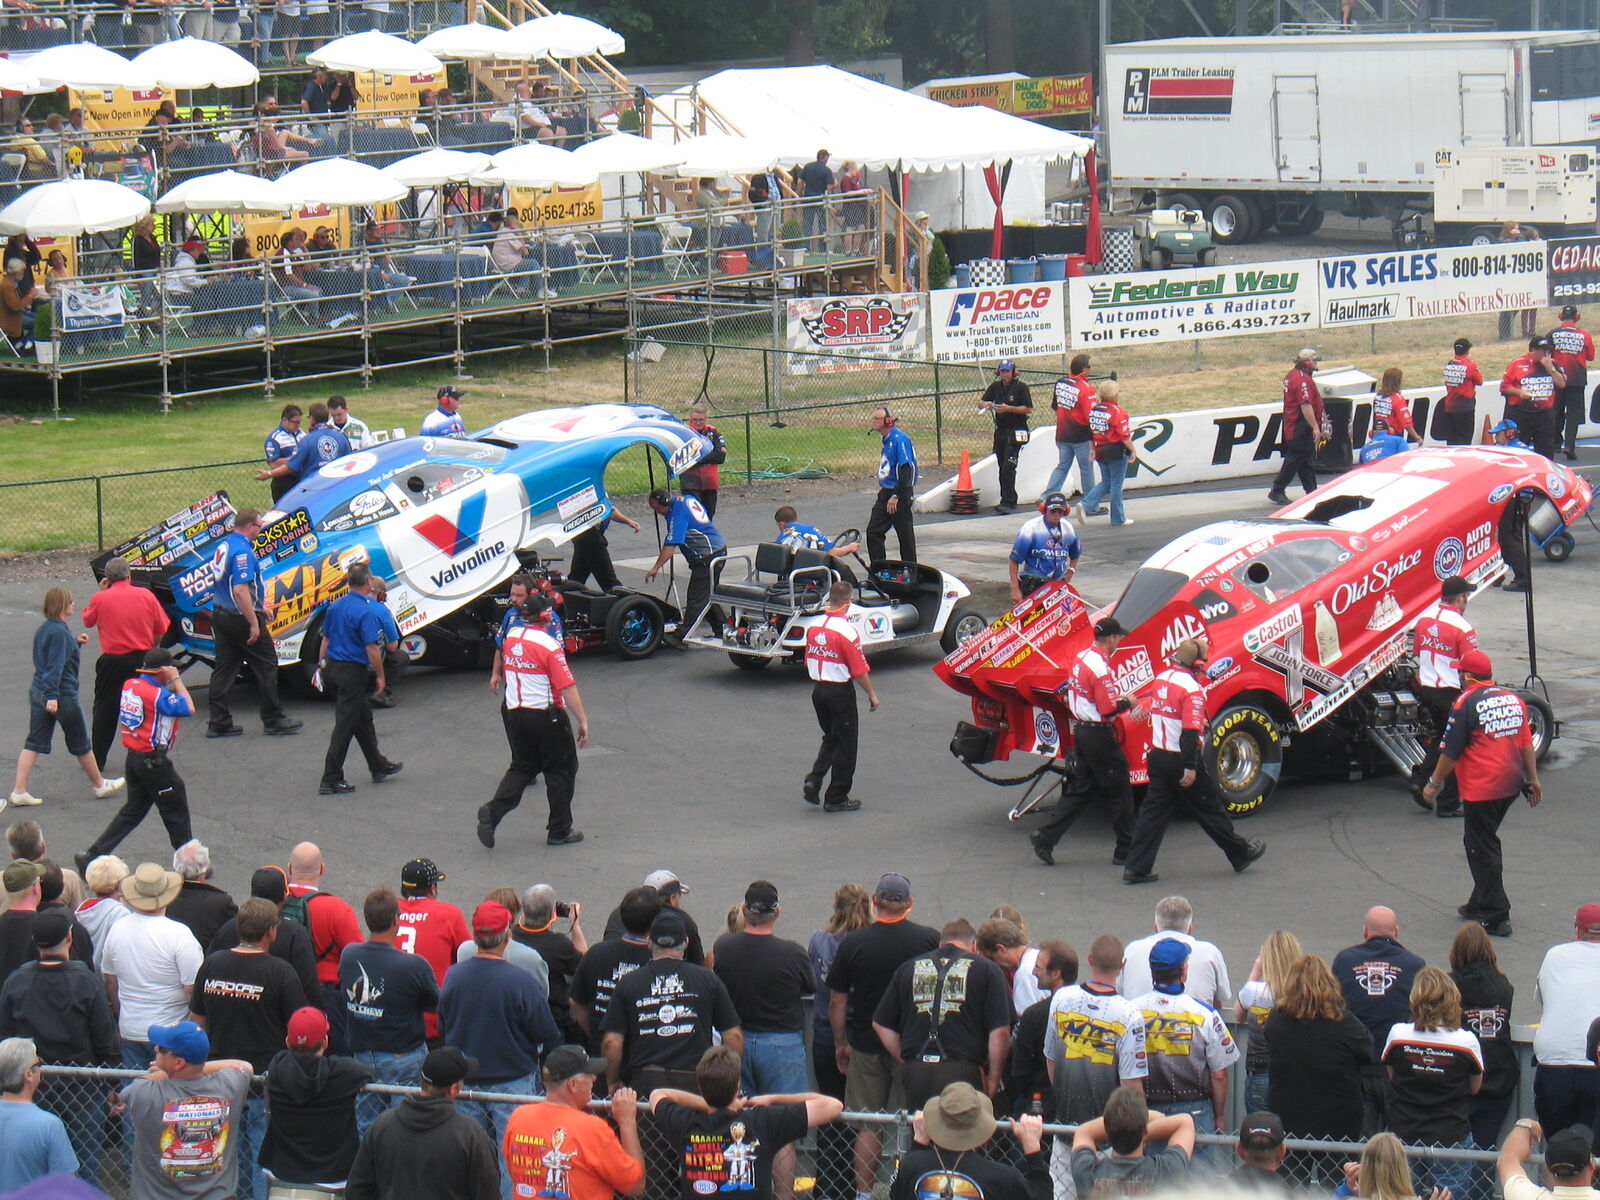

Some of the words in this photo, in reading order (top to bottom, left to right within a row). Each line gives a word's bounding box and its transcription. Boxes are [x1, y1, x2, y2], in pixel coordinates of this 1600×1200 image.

[1150, 68, 1169, 77] PLM
[1172, 68, 1200, 77] Trailer
[1202, 67, 1235, 79] Leasing
[391, 89, 410, 102] Open
[930, 89, 967, 101] CHICKEN
[970, 86, 999, 99] STRIPS
[1026, 100, 1047, 110] DOGS
[111, 109, 132, 121] Open
[1435, 151, 1452, 164] CAT
[1323, 261, 1358, 290] VR
[1366, 253, 1438, 287] SALES
[1452, 252, 1544, 278] 800-814-7996
[1111, 274, 1227, 303] Federal
[1235, 271, 1299, 293] Way
[970, 286, 1051, 325] pace
[1095, 305, 1195, 325] Automotive
[1205, 302, 1214, 315] &
[1224, 299, 1296, 314] Radiator
[1329, 301, 1391, 321] Haulmark
[823, 307, 892, 338] SRP
[981, 311, 1038, 323] AMERICAN
[946, 321, 1052, 339] www.TruckTownSales.com
[1081, 329, 1113, 342] Toll
[1120, 327, 1160, 339] Free
[1177, 312, 1312, 335] 1.866.439.7237
[966, 333, 1033, 348] 1-800-671-0026
[936, 352, 951, 362] BIG
[953, 347, 996, 360] Discounts!
[999, 346, 1020, 356] HUGE
[1022, 343, 1063, 356] Selection!
[206, 505, 233, 524] FRAM
[565, 508, 603, 531] FREIGHTLINER
[254, 540, 278, 558] ERGY
[281, 523, 312, 545] DRINK
[1466, 521, 1492, 542] AUTO
[1215, 550, 1249, 574] MIKE
[1246, 535, 1276, 556] NEFF
[1466, 536, 1491, 561] CLUB
[180, 560, 215, 588] MAT
[430, 540, 505, 589] Valvoline
[1331, 575, 1370, 615] Old
[1369, 549, 1423, 593] Spice
[271, 617, 289, 632] MAIL
[400, 611, 428, 633] FRAM
[1258, 611, 1300, 645] Castrol
[1161, 613, 1206, 659] MAC
[816, 646, 841, 659] Spice
[513, 656, 538, 670] Spice
[954, 651, 981, 674] FEATHERLITE
[1270, 649, 1300, 670] JOHN
[1300, 661, 1335, 688] FORCE
[1475, 694, 1520, 713] CHECKER
[1212, 709, 1279, 747] GOODYEAR
[1484, 716, 1523, 735] KRAGEN
[1494, 731, 1506, 739] AUTO
[1506, 729, 1519, 737] PARTS
[1227, 795, 1263, 812] EAGLE
[204, 979, 265, 995] MADCAP
[651, 985, 685, 996] PIZZA
[1403, 1045, 1454, 1057] Harley-Davidson
[1411, 1063, 1424, 1071] Motor
[1425, 1064, 1445, 1073] Company
[178, 1110, 221, 1118] NATIONALS
[685, 1152, 724, 1167] NITRO
